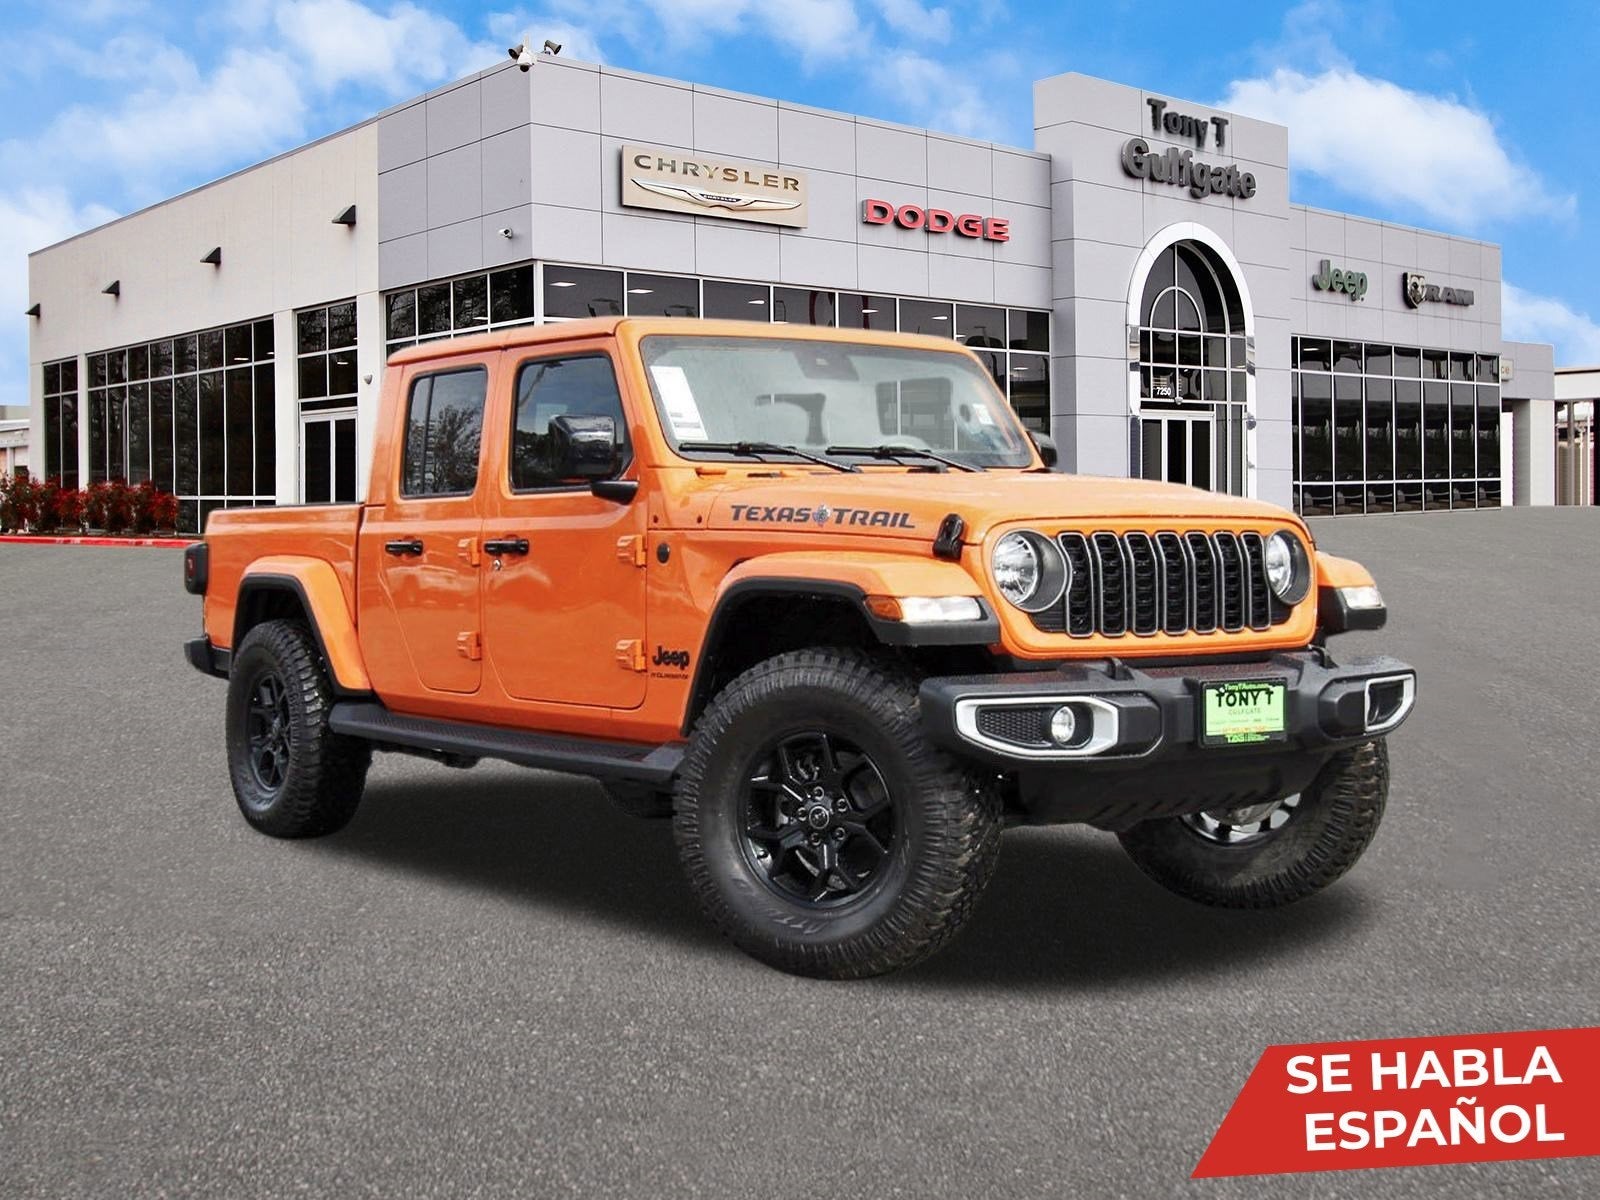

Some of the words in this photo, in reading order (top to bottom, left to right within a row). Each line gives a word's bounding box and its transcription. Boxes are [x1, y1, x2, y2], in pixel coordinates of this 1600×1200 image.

[1147, 98, 1208, 148] Tony
[1211, 116, 1229, 148] T
[634, 154, 801, 192] CHRYSLER
[1121, 138, 1257, 199] Gulfgate
[862, 199, 1011, 242] DODGE
[1312, 259, 1368, 301] Jeep
[1425, 284, 1475, 306] RAM
[1156, 387, 1172, 396] 7250
[731, 505, 811, 522] TEXAS
[833, 508, 915, 528] TRAIL
[652, 645, 690, 671] Jeep
[1216, 689, 1261, 707] TONY
[1265, 690, 1274, 705] T
